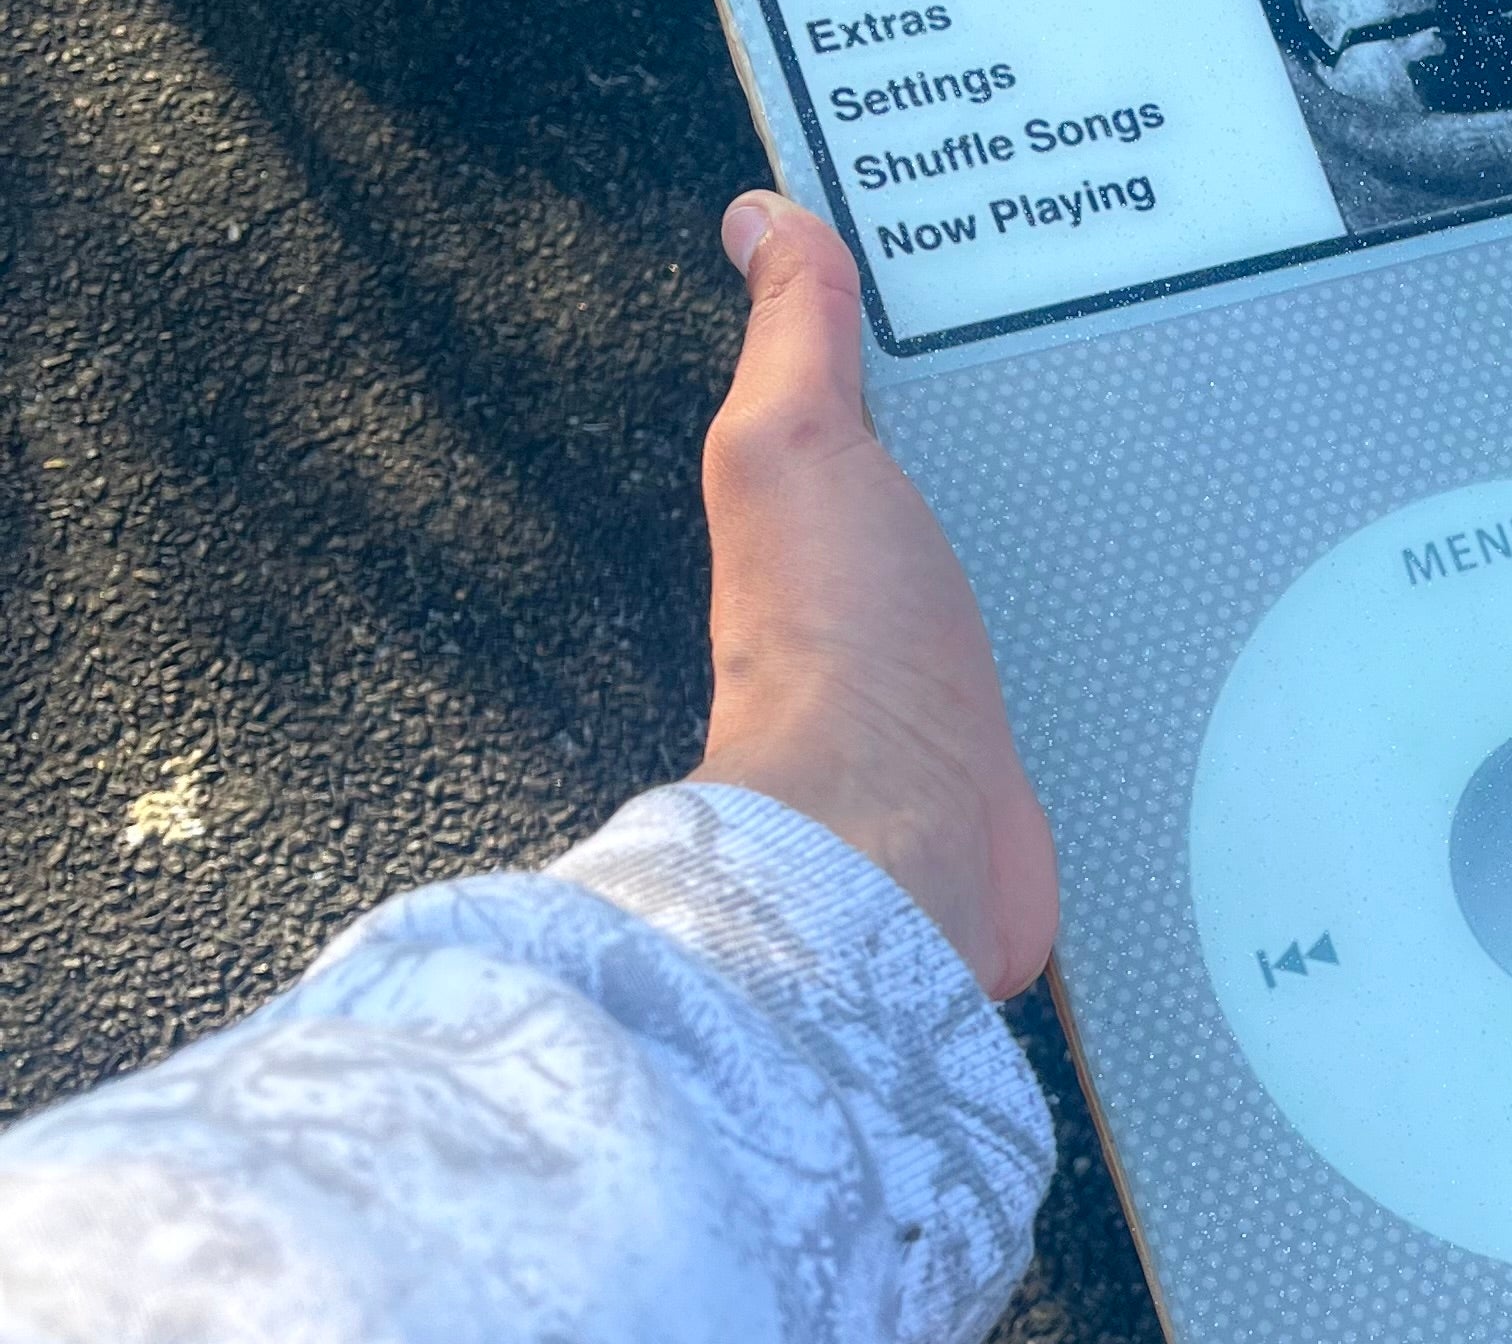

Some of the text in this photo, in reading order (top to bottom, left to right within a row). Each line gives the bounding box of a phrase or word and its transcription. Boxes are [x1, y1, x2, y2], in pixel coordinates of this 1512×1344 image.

[805, 4, 953, 54] Extras
[830, 62, 1016, 122] Settings
[854, 102, 1165, 190] Shuffle Songs
[877, 175, 1157, 258] Now Playing
